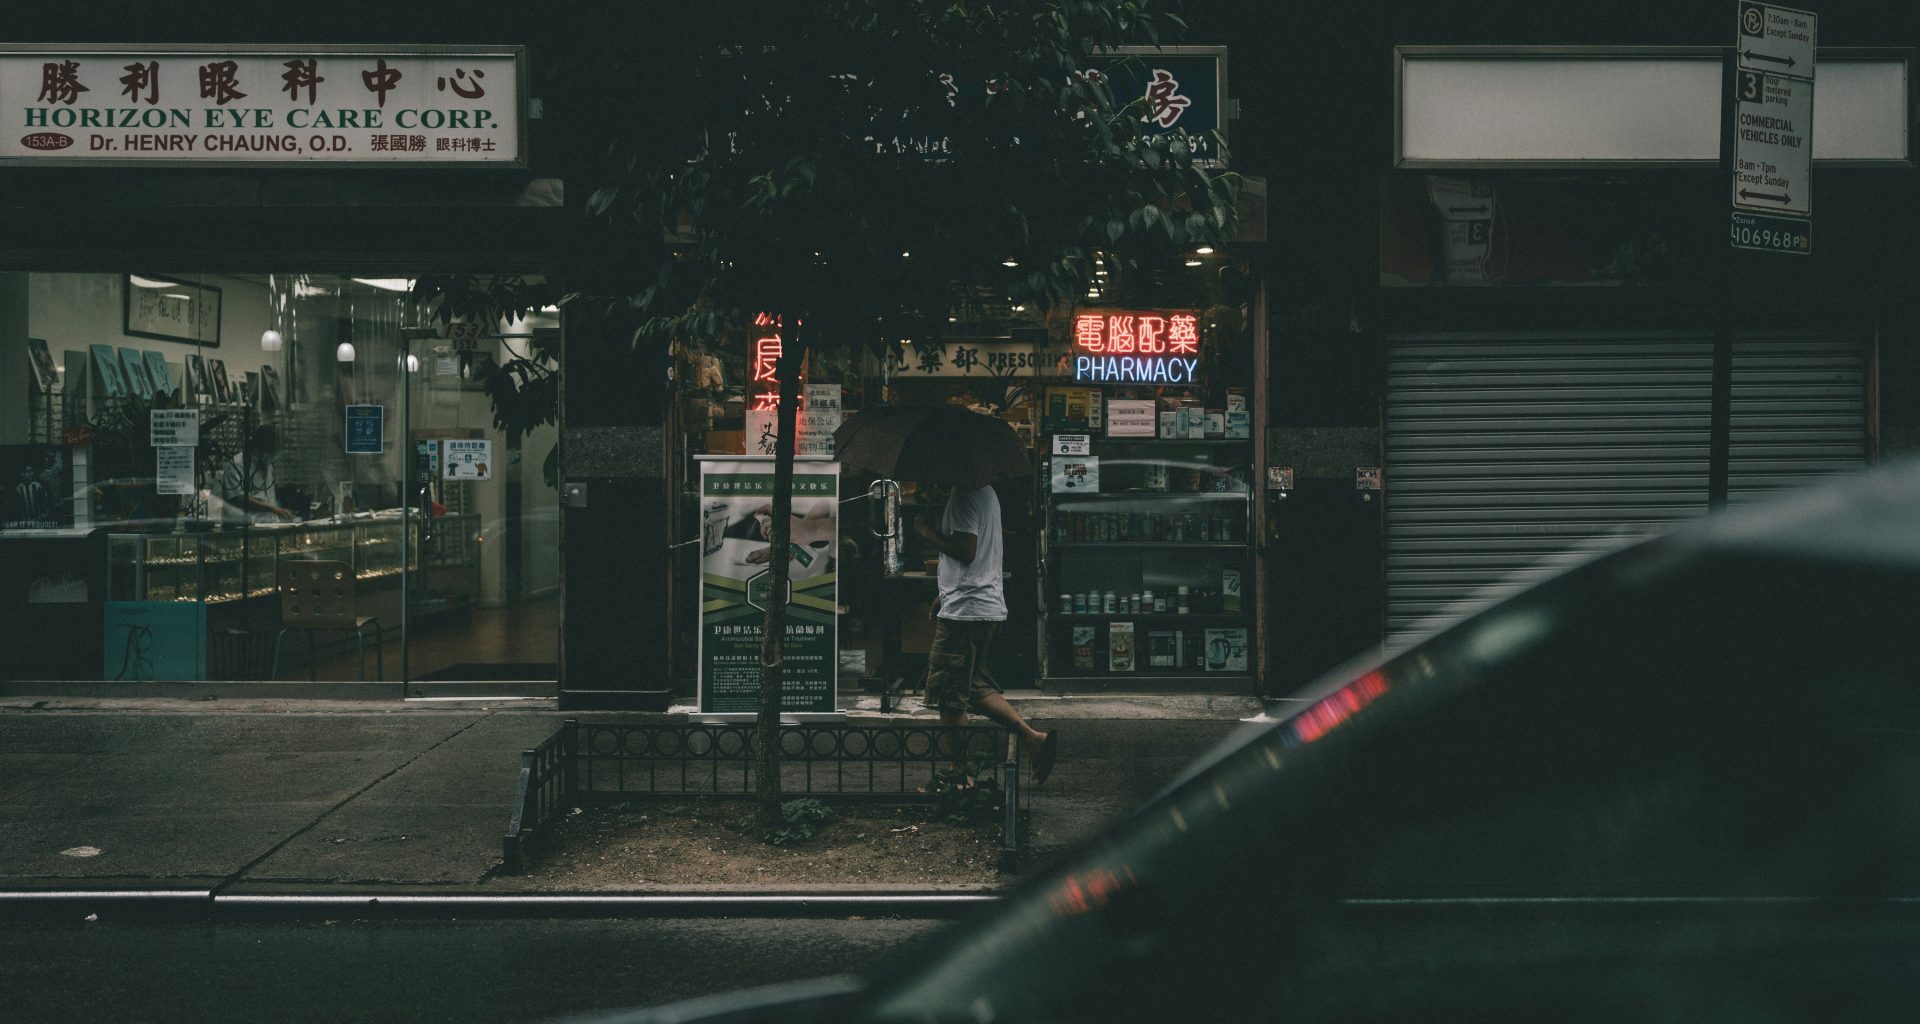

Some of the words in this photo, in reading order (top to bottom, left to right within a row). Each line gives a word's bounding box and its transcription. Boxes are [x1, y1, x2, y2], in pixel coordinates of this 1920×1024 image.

[1767, 13, 1790, 27] 7:30am
[1795, 18, 1808, 29] 8am
[1766, 27, 1788, 39] Except
[1788, 30, 1810, 43] Sunday
[37, 59, 485, 108] 勝利眼科中心
[1744, 72, 1757, 99] 3
[1765, 85, 1792, 98] metered
[1765, 95, 1788, 107] parking
[24, 108, 194, 129] HORIZON
[203, 109, 275, 129] EYE
[286, 109, 384, 129] CARE
[394, 109, 499, 129] CORP.
[1740, 113, 1794, 133] COMMERCIAL
[24, 135, 70, 149] 153A-B
[90, 134, 118, 151] Dr.
[124, 135, 198, 151] HENRY
[204, 134, 303, 154] CHAUNG,
[310, 135, 352, 152] O.D.
[371, 134, 427, 152] 張國勝
[436, 137, 496, 152] 眼科博士
[1740, 129, 1779, 145] VEHICLES
[1781, 135, 1803, 148] ONLY
[1761, 162, 1777, 174] 7pm
[1738, 171, 1763, 186] Except
[1764, 175, 1790, 190] Sunday
[1076, 314, 1200, 354] 電腦配藥
[887, 345, 979, 374] 藥部
[1076, 355, 1199, 383] PHARMACY
